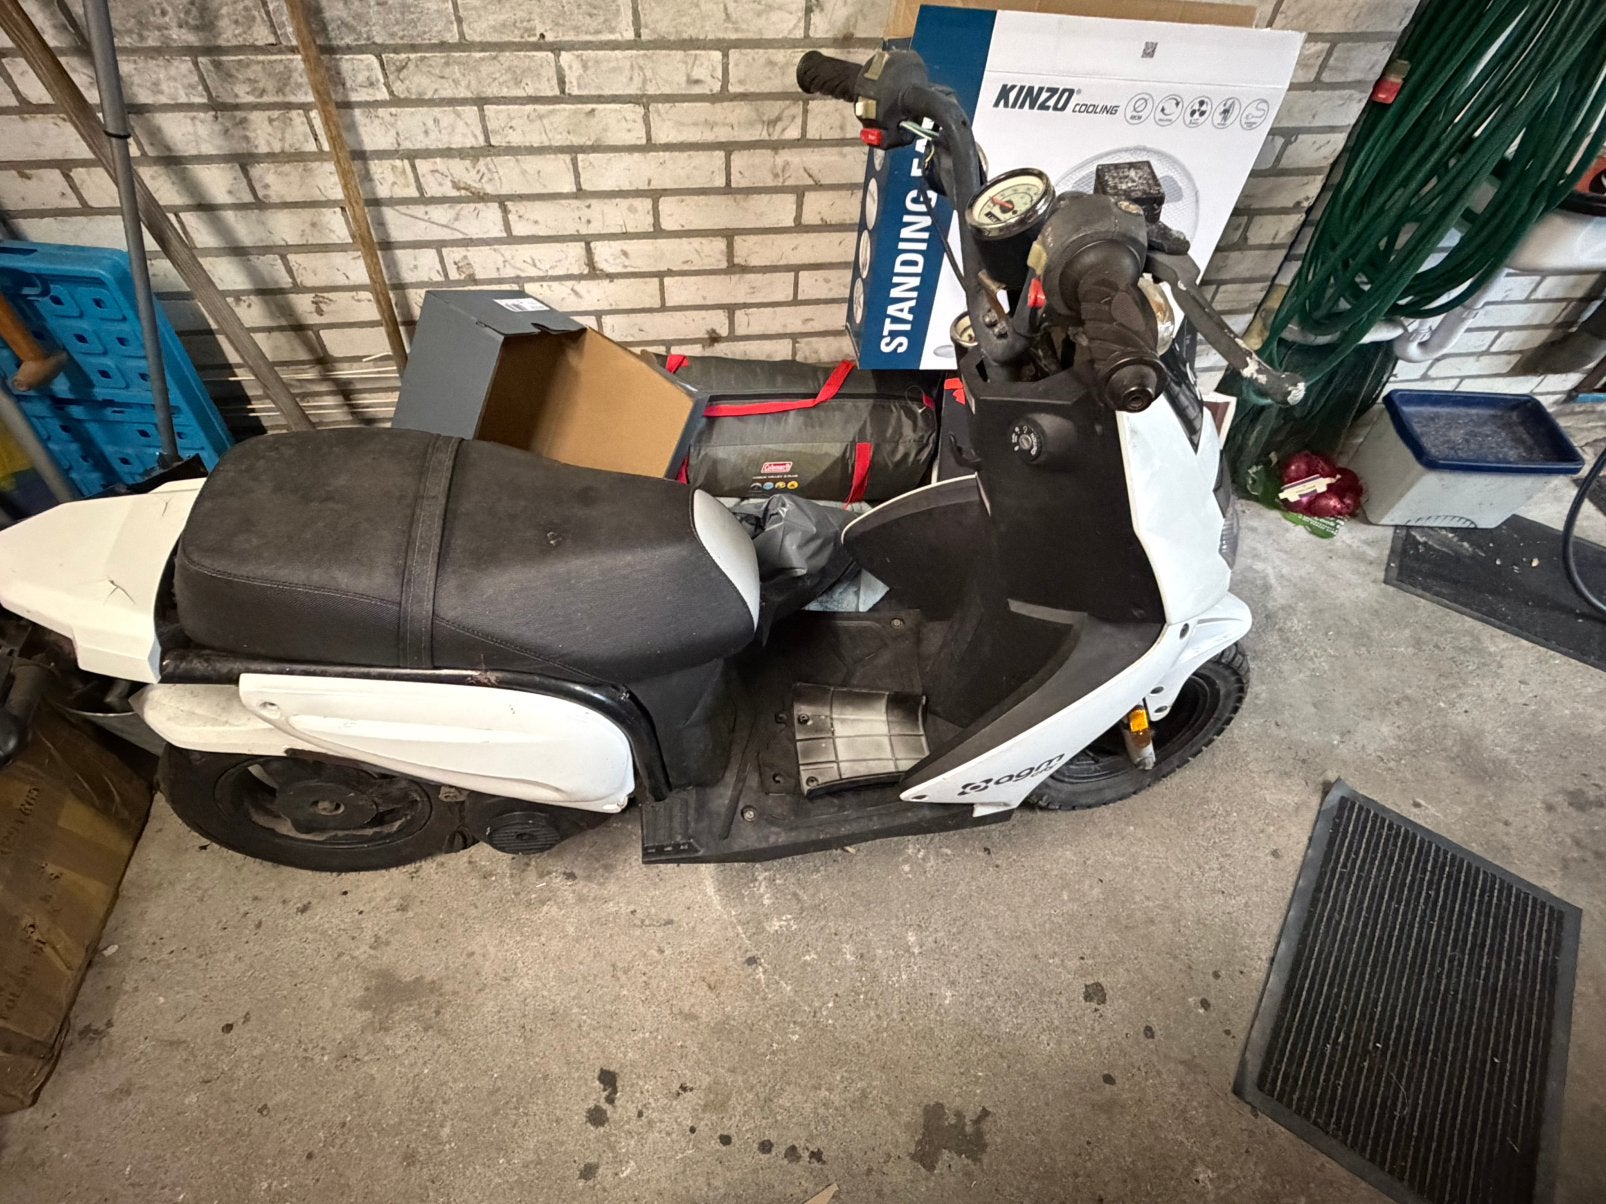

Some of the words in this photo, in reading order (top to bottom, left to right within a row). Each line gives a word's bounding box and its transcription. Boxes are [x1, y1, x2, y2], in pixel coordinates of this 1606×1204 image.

[992, 84, 1075, 113] KINZO
[1072, 103, 1120, 116] COOLING
[879, 188, 938, 355] STANDING
[994, 753, 1065, 785] agm
